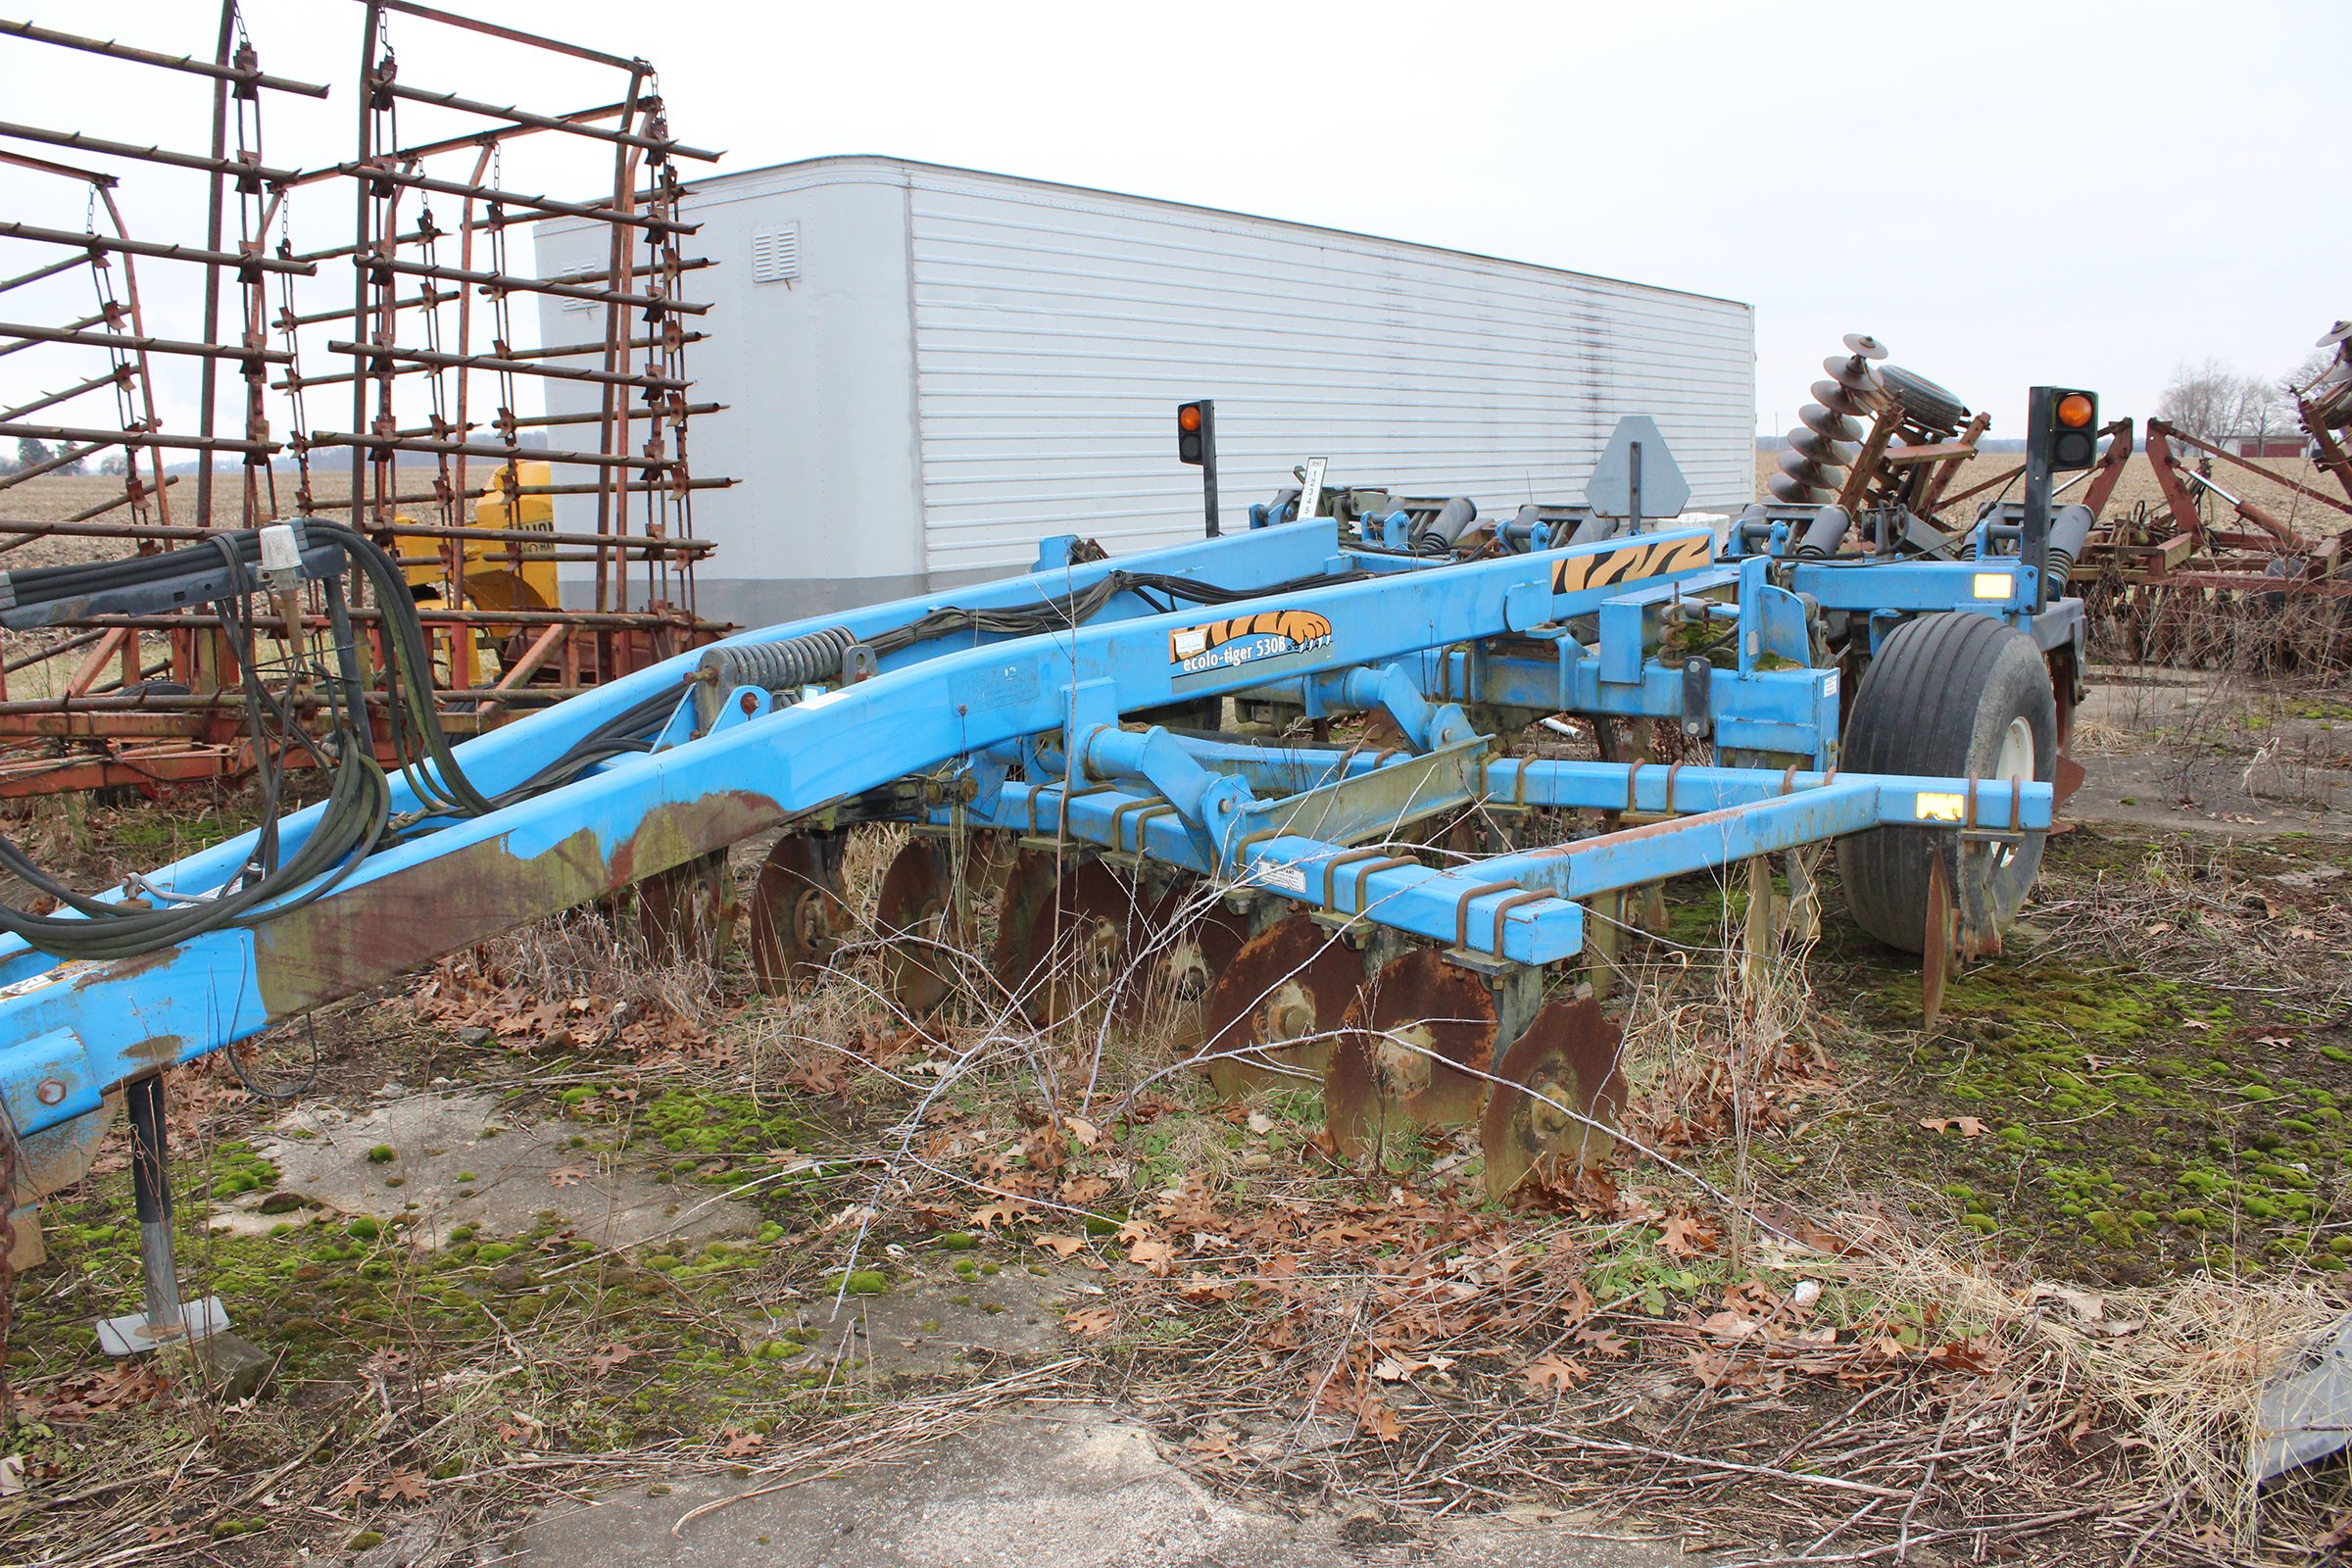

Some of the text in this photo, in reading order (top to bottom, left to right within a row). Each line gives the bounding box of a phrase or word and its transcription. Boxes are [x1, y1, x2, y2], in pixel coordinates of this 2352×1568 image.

[1304, 506, 1310, 514] 5
[1183, 635, 1286, 671] ecolo-tiger 530B
